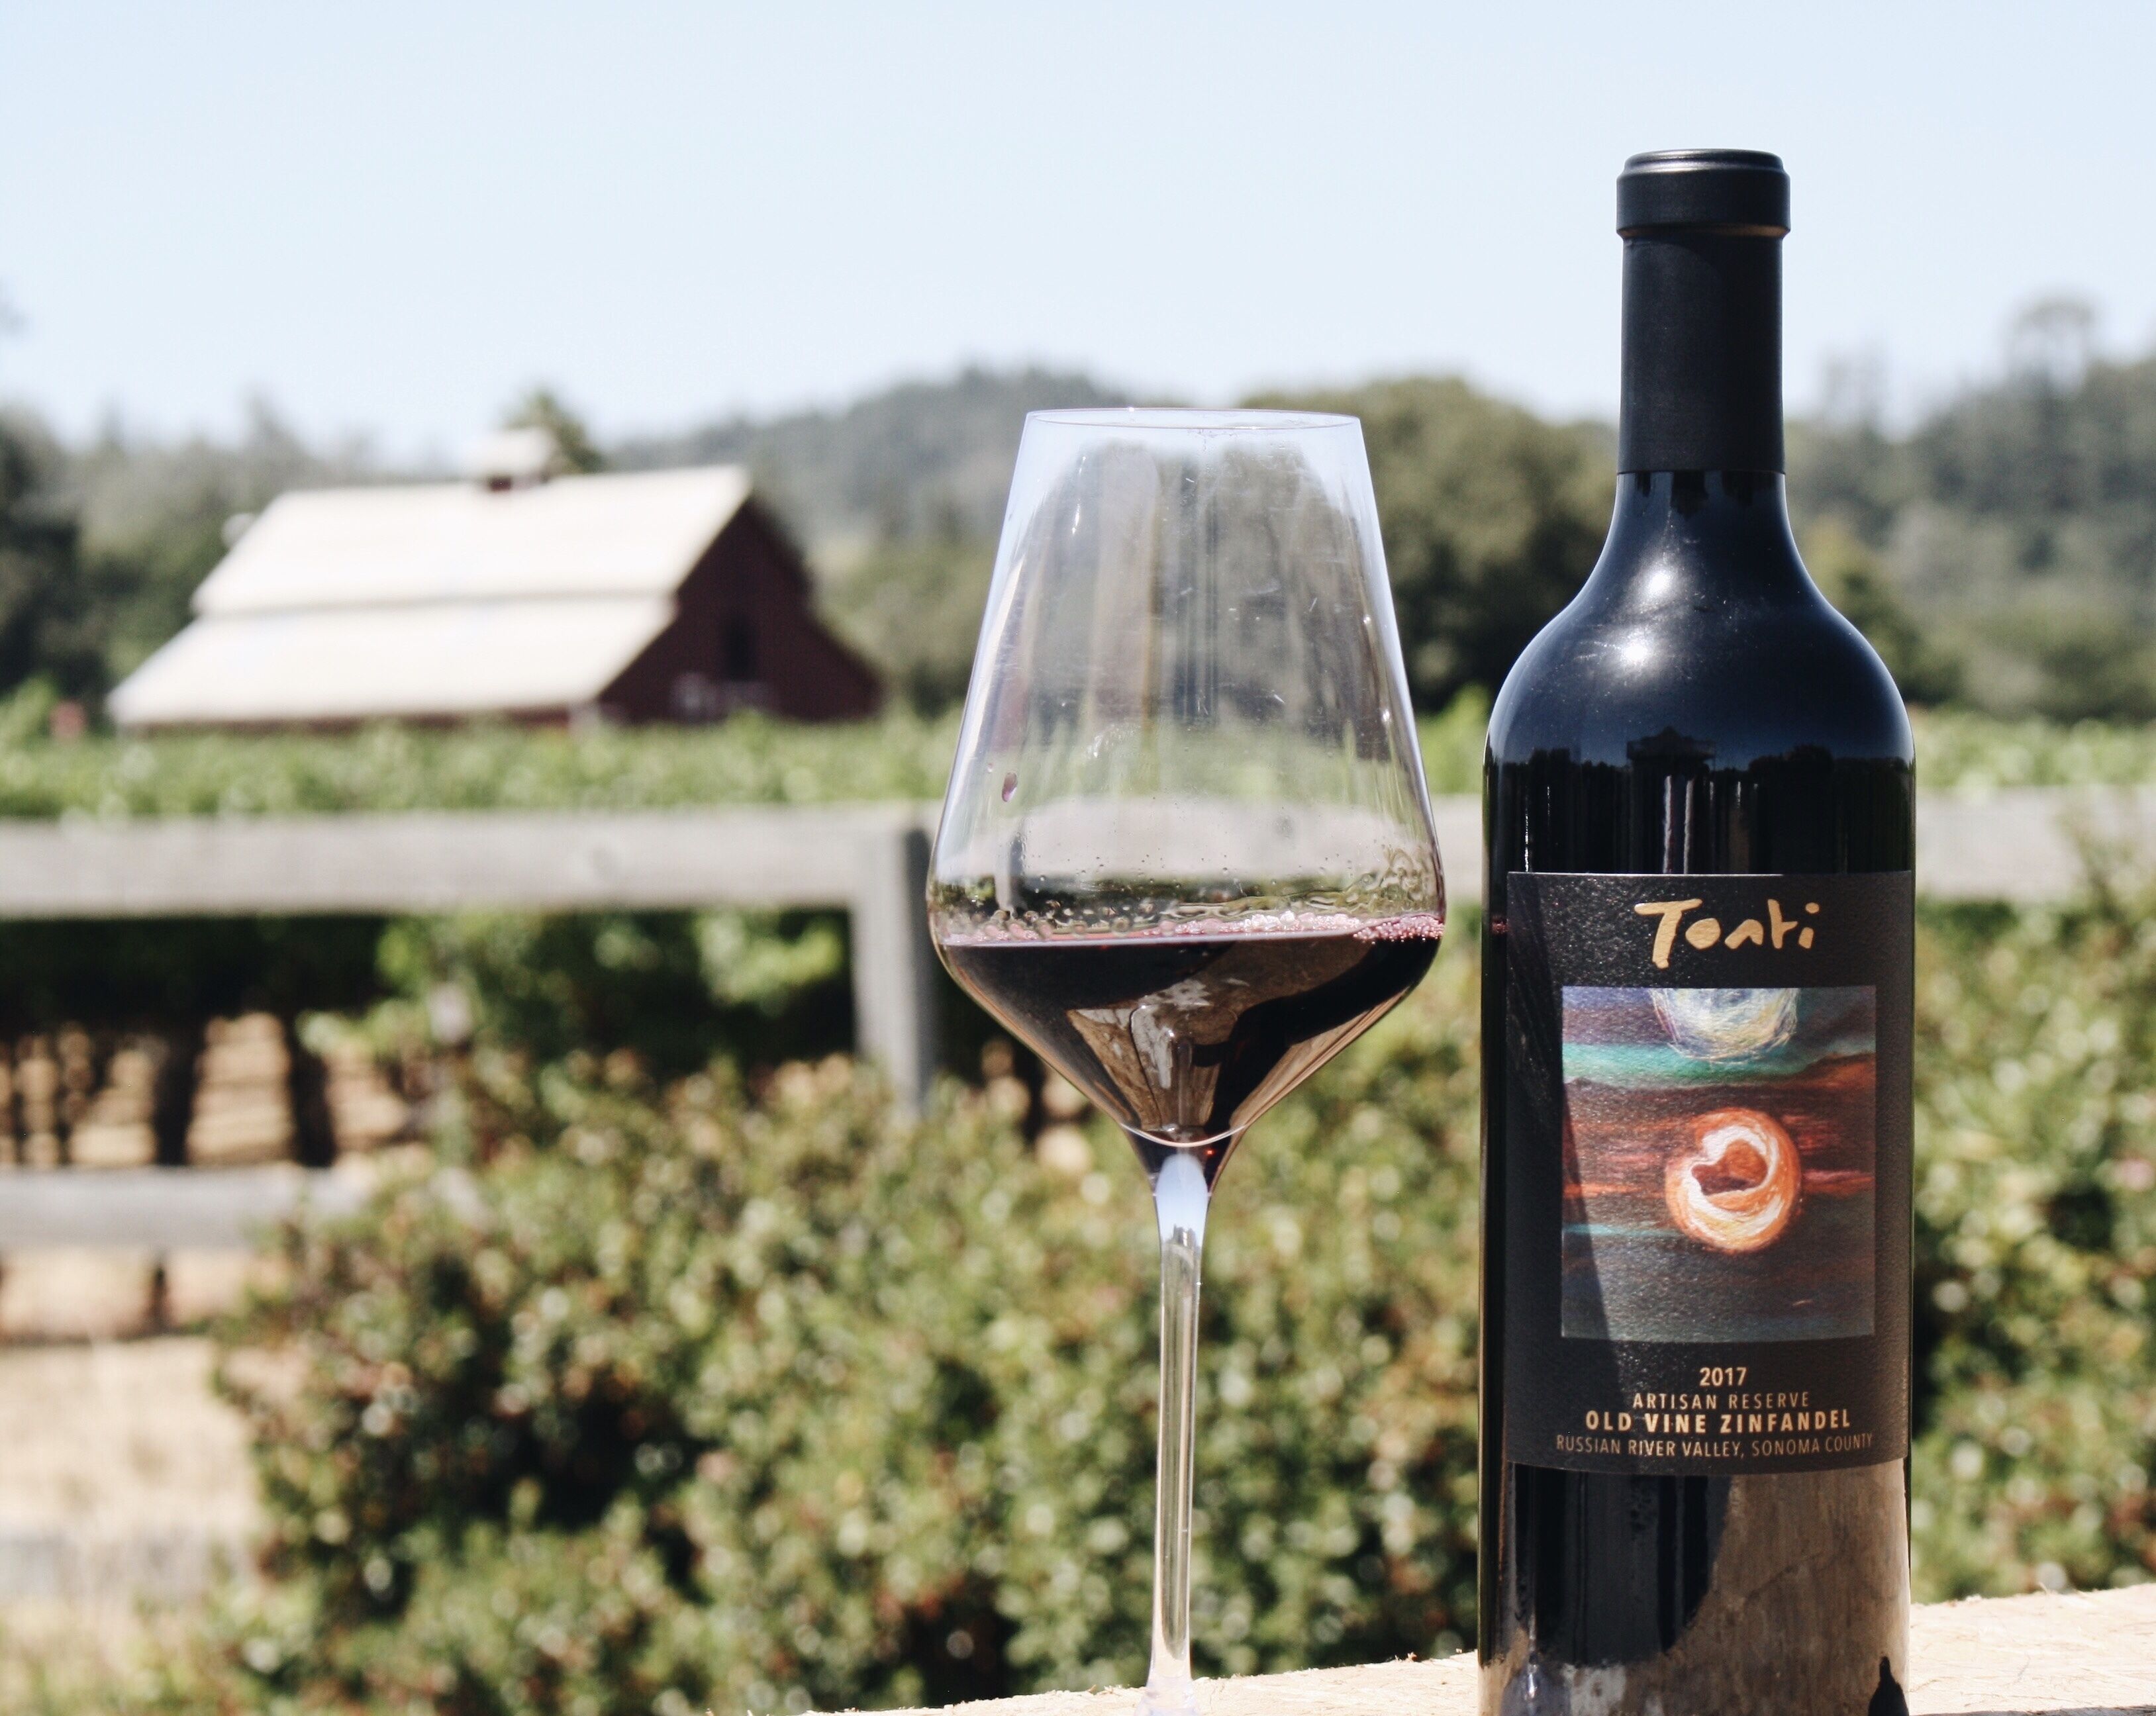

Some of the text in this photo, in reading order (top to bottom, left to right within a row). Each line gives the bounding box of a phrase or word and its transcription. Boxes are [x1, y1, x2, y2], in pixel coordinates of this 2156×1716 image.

[1634, 898, 1820, 969] Tonti
[1699, 1367, 1747, 1386] 2017
[1632, 1392, 1809, 1410] ARTISAN RESERVE
[1585, 1409, 1850, 1433] OLD VINE ZINFANDEL
[1557, 1432, 1872, 1459] RUSSIAN RIVER VALLEY, SONOMA COUNTY
